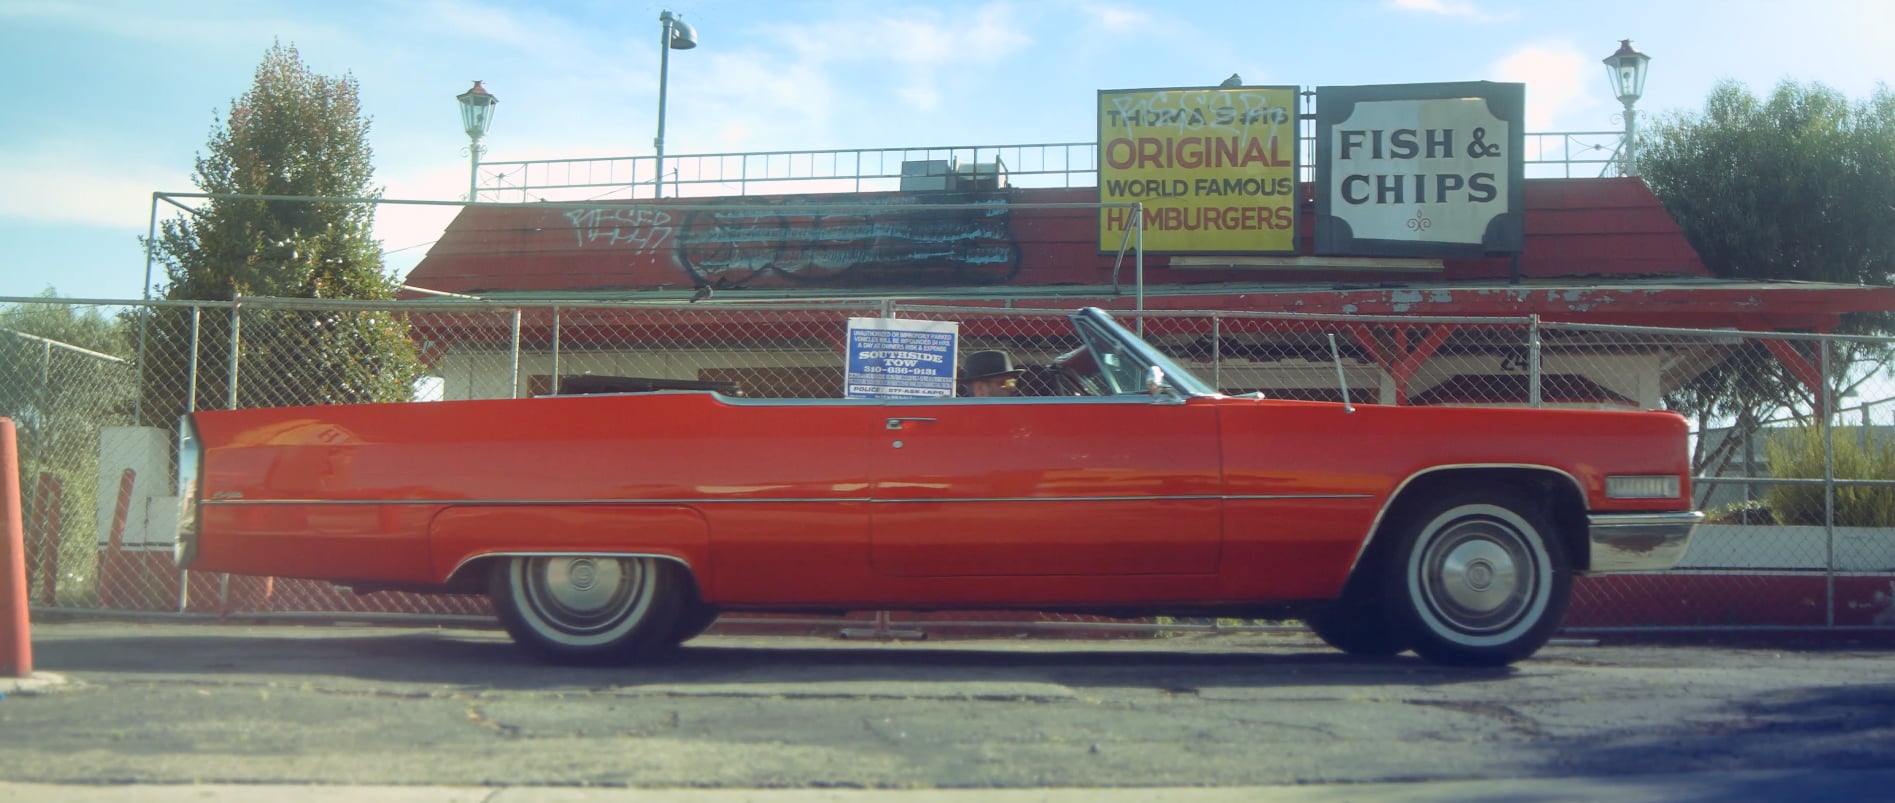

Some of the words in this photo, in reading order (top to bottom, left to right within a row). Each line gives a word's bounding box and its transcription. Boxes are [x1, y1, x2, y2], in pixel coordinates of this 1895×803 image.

[1106, 136, 1291, 169] ORIGINAL
[1339, 128, 1455, 160] FISH
[1466, 126, 1502, 159] &
[1106, 179, 1188, 197] WORLD
[1195, 177, 1292, 196] FAMOUS
[1340, 172, 1498, 205] CHIPS
[1107, 206, 1292, 231] HAMBURGERS
[858, 351, 943, 363] SOUTHSIDE
